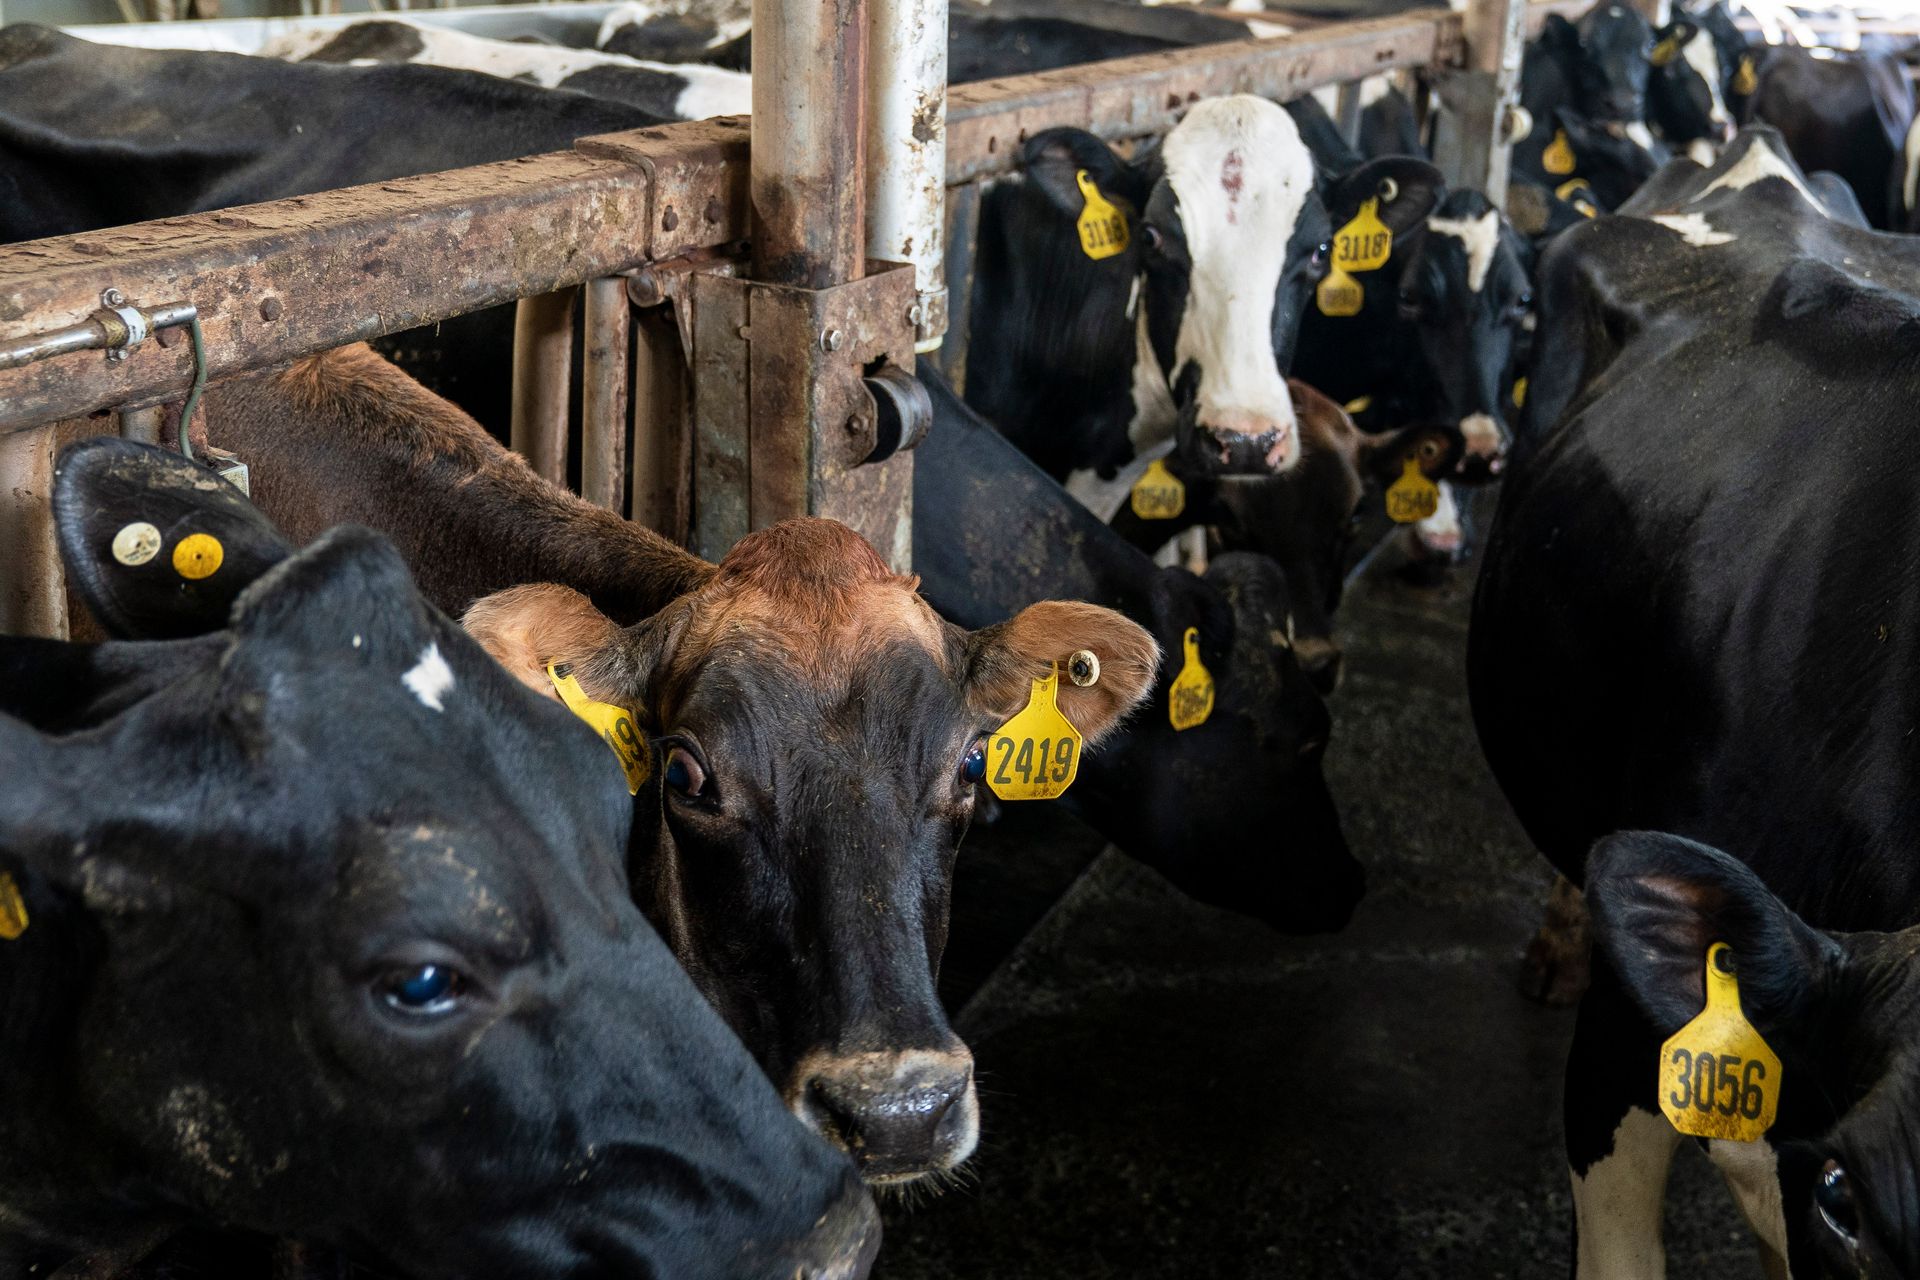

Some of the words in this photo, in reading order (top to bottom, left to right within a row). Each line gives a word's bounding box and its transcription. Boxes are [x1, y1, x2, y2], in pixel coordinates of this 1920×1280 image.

[1339, 232, 1388, 261] 3118
[993, 736, 1075, 785] 2419
[1669, 1048, 1766, 1120] 3056
